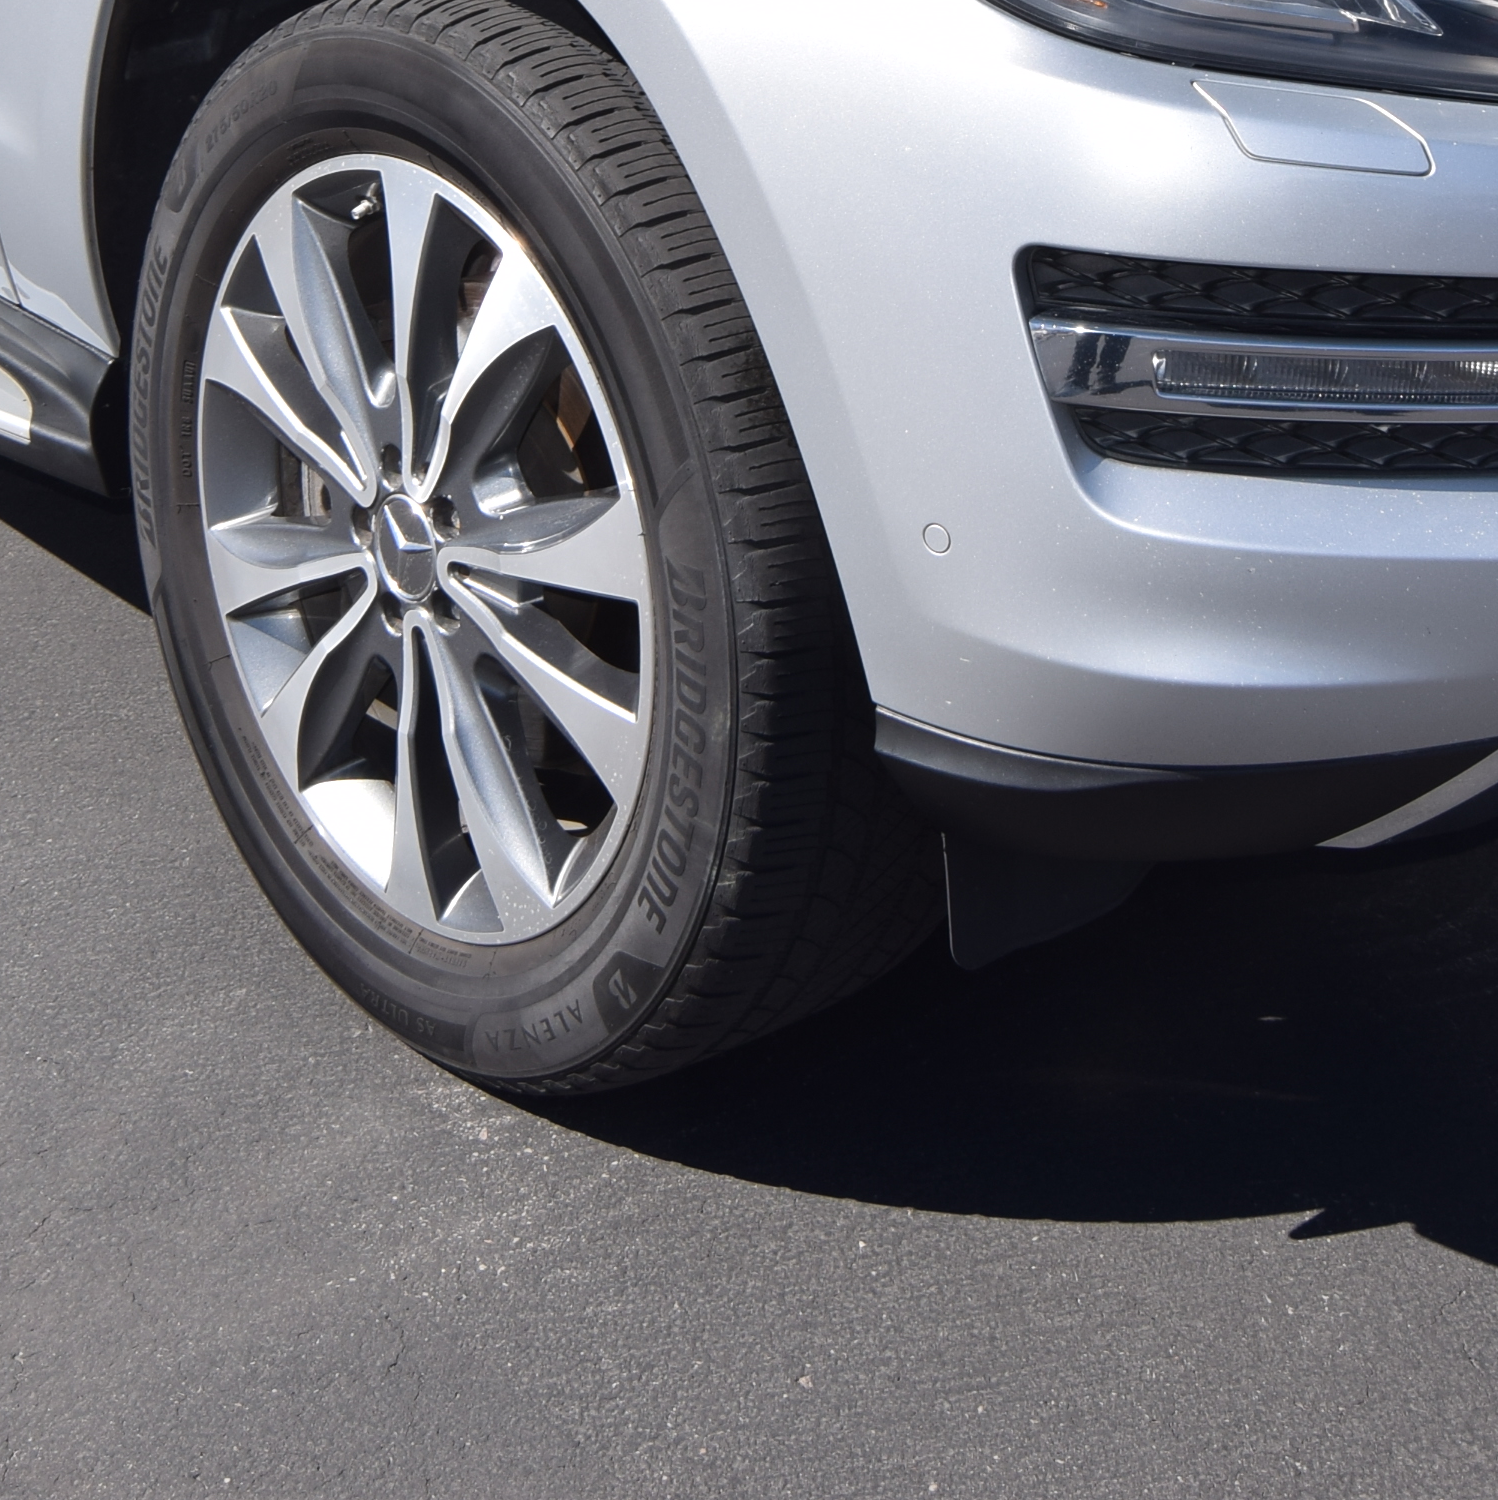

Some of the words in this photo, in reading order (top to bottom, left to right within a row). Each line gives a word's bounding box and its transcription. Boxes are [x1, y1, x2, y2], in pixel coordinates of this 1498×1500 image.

[130, 239, 171, 550] BRIDGESTONE
[637, 561, 707, 935] BRIDGESTONE
[359, 982, 410, 1027] ULTRA
[415, 1016, 436, 1037] AS
[484, 998, 584, 1052] ALENZA
